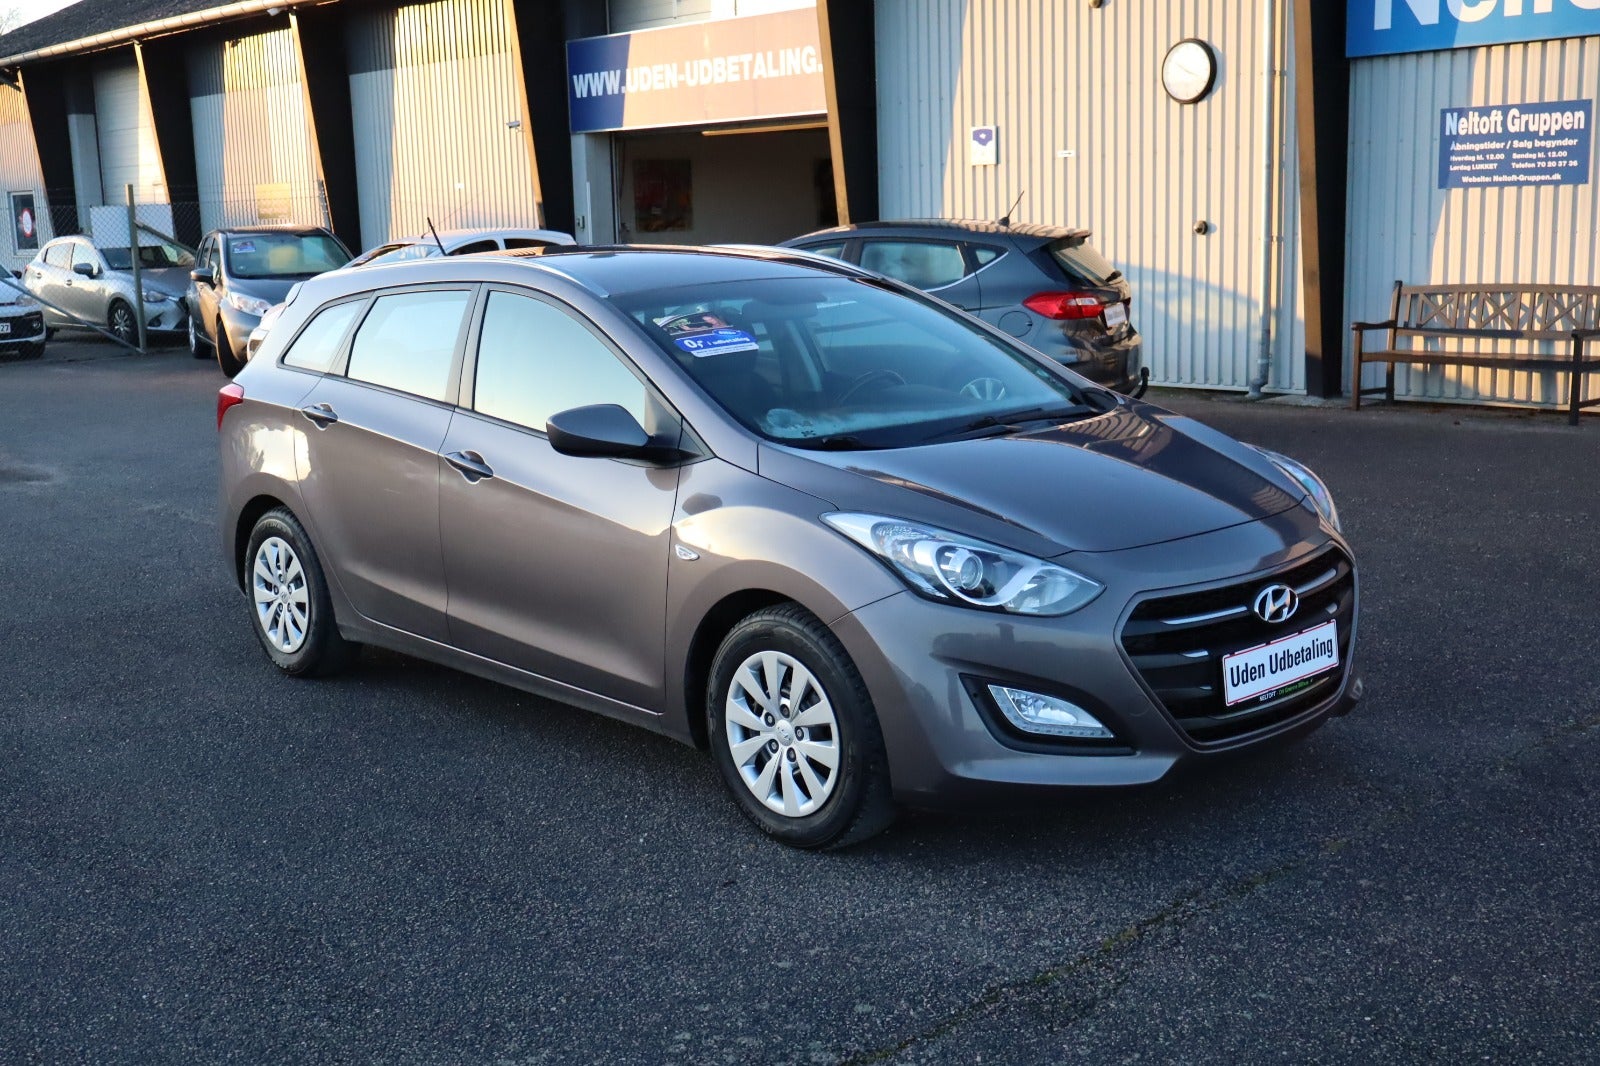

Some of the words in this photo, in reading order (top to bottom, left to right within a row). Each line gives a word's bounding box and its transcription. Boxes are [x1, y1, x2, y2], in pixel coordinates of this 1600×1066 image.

[573, 45, 824, 98] WWW.UDEN-UDBETALING.
[1445, 110, 1502, 135] Neltoft
[1507, 108, 1585, 136] Gruppen
[1451, 141, 1505, 150] Åbningstider
[1513, 140, 1532, 149] Salg
[1535, 138, 1578, 148] begynder
[1230, 662, 1265, 688] Uden
[1269, 638, 1333, 674] Udbetaling
